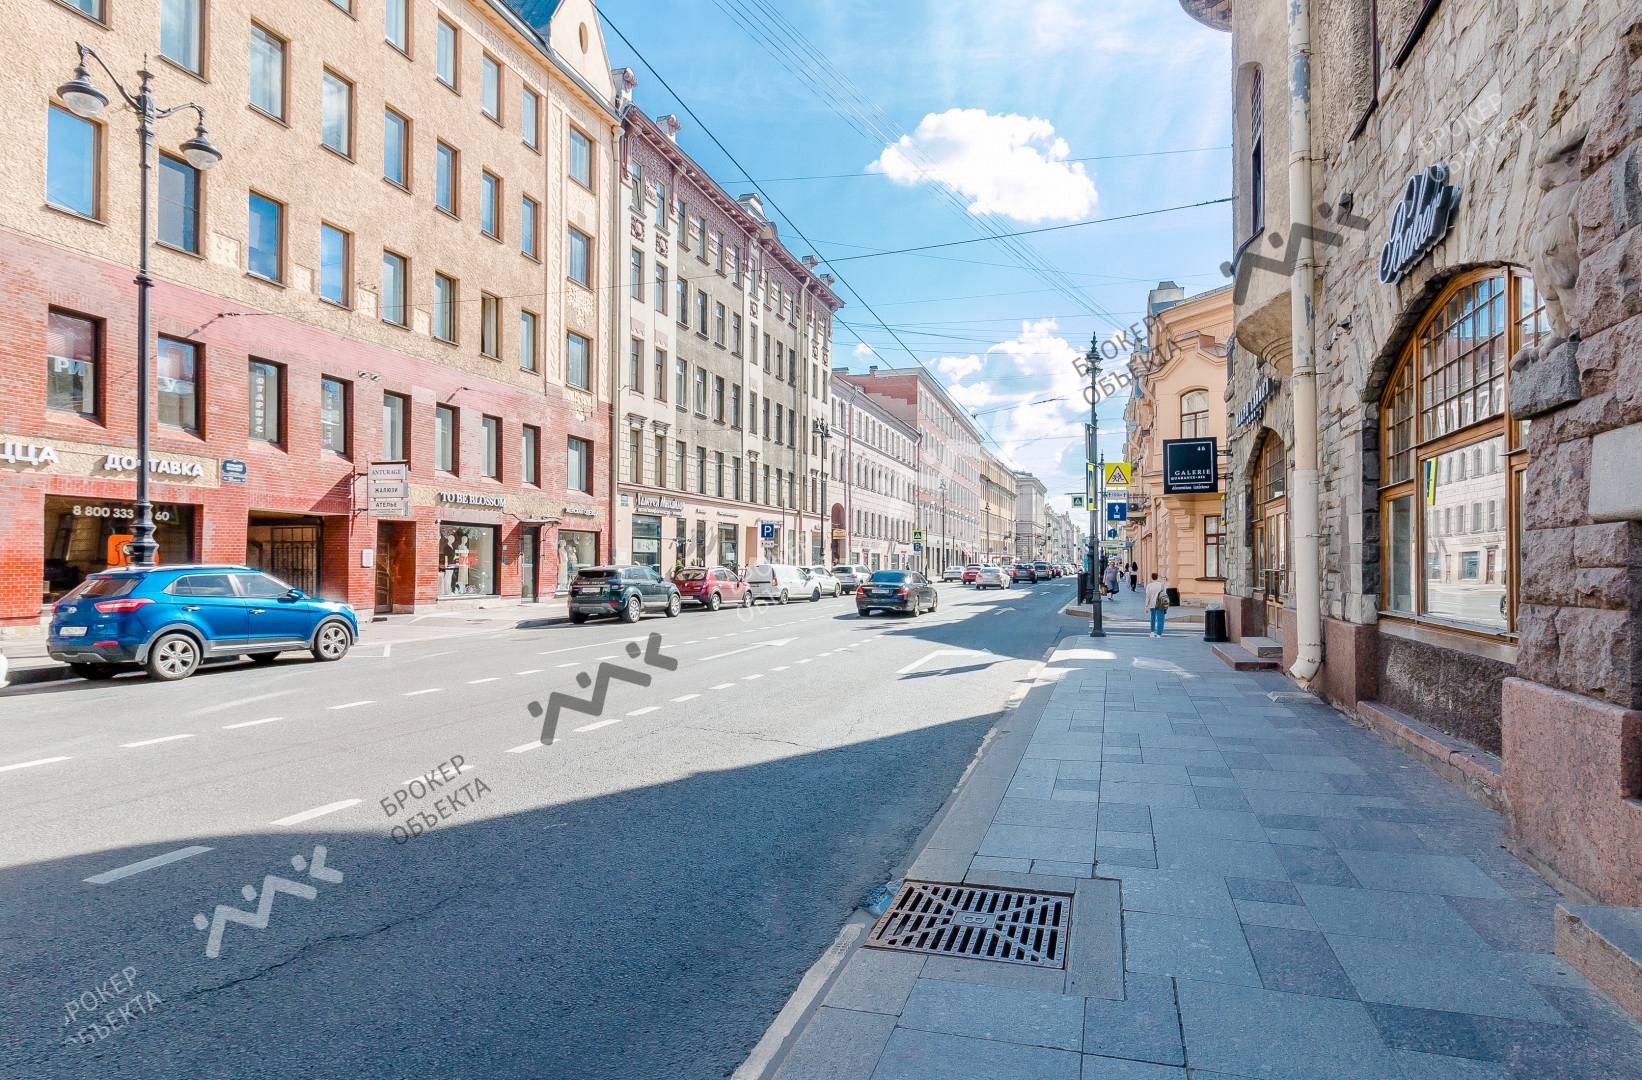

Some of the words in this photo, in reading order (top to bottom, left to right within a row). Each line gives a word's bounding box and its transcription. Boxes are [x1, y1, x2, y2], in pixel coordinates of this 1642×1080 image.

[104, 453, 205, 477] ДОТАВКА
[440, 491, 455, 503] TO
[456, 494, 469, 504] BE
[469, 495, 506, 507] BLOSSOM
[72, 504, 82, 516] 8
[84, 505, 111, 518] 800
[112, 507, 135, 519] 333
[154, 510, 170, 521] 60
[764, 525, 772, 537] P
